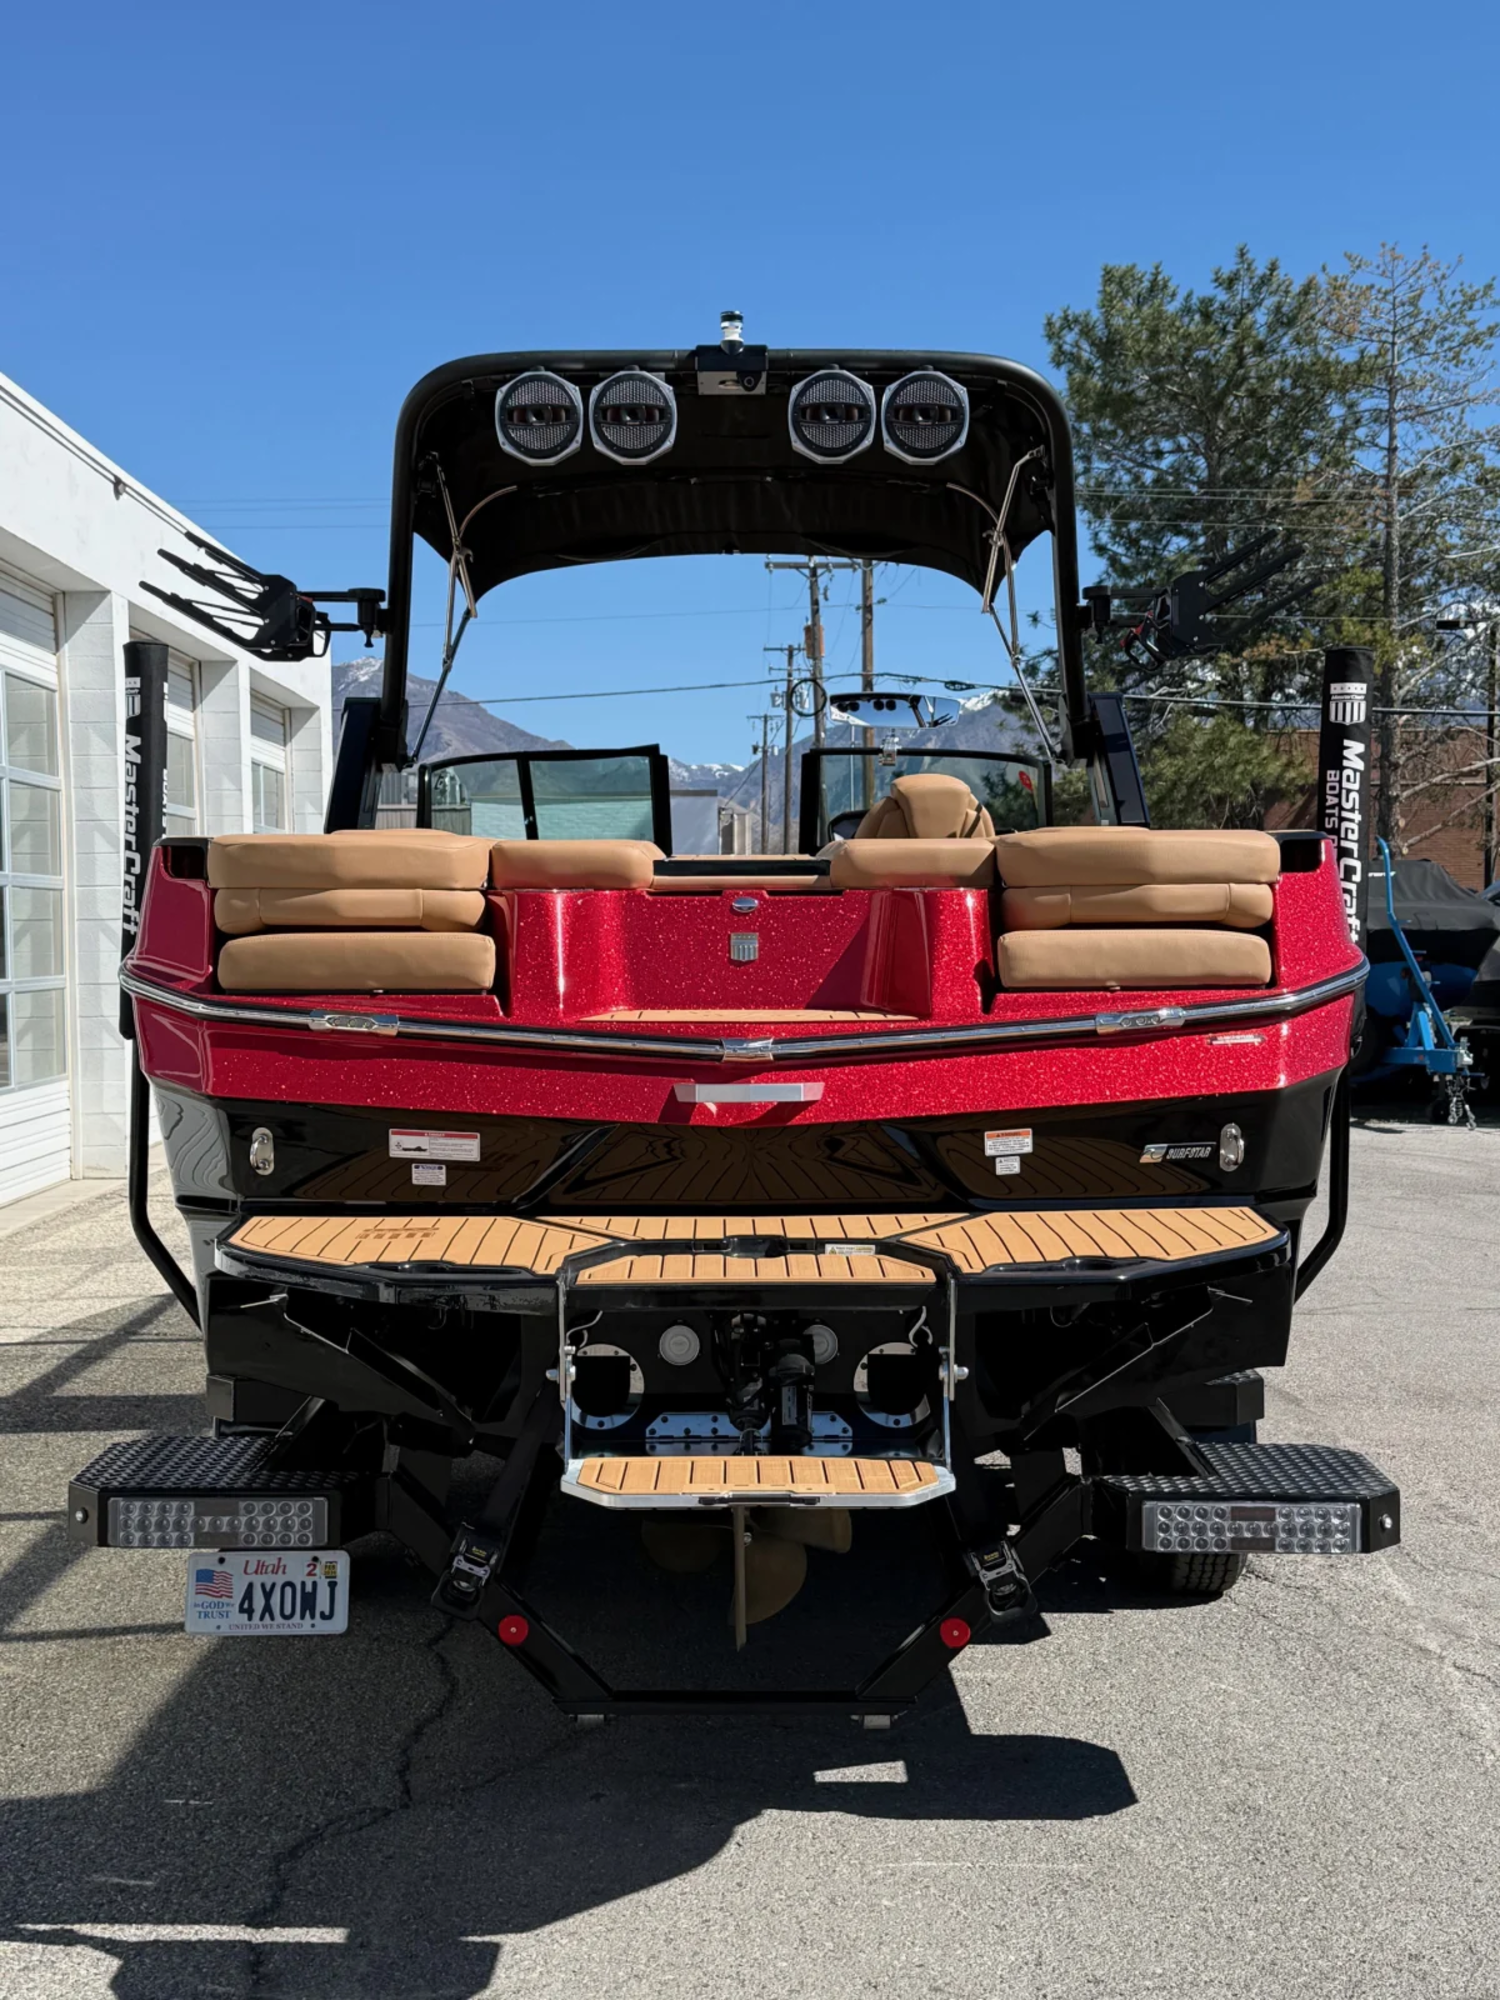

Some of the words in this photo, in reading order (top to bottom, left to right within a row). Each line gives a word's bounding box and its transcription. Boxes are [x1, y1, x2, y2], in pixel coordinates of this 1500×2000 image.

[1325, 770, 1339, 829] BOATS
[1166, 1146, 1212, 1160] SURFSTAR
[243, 1557, 287, 1576] Utah
[306, 1562, 318, 1577] 2
[201, 1600, 225, 1610] GOD
[196, 1610, 232, 1620] TRUST
[229, 1623, 260, 1631] UNITED
[261, 1622, 276, 1630] WE
[276, 1622, 304, 1630] STAND
